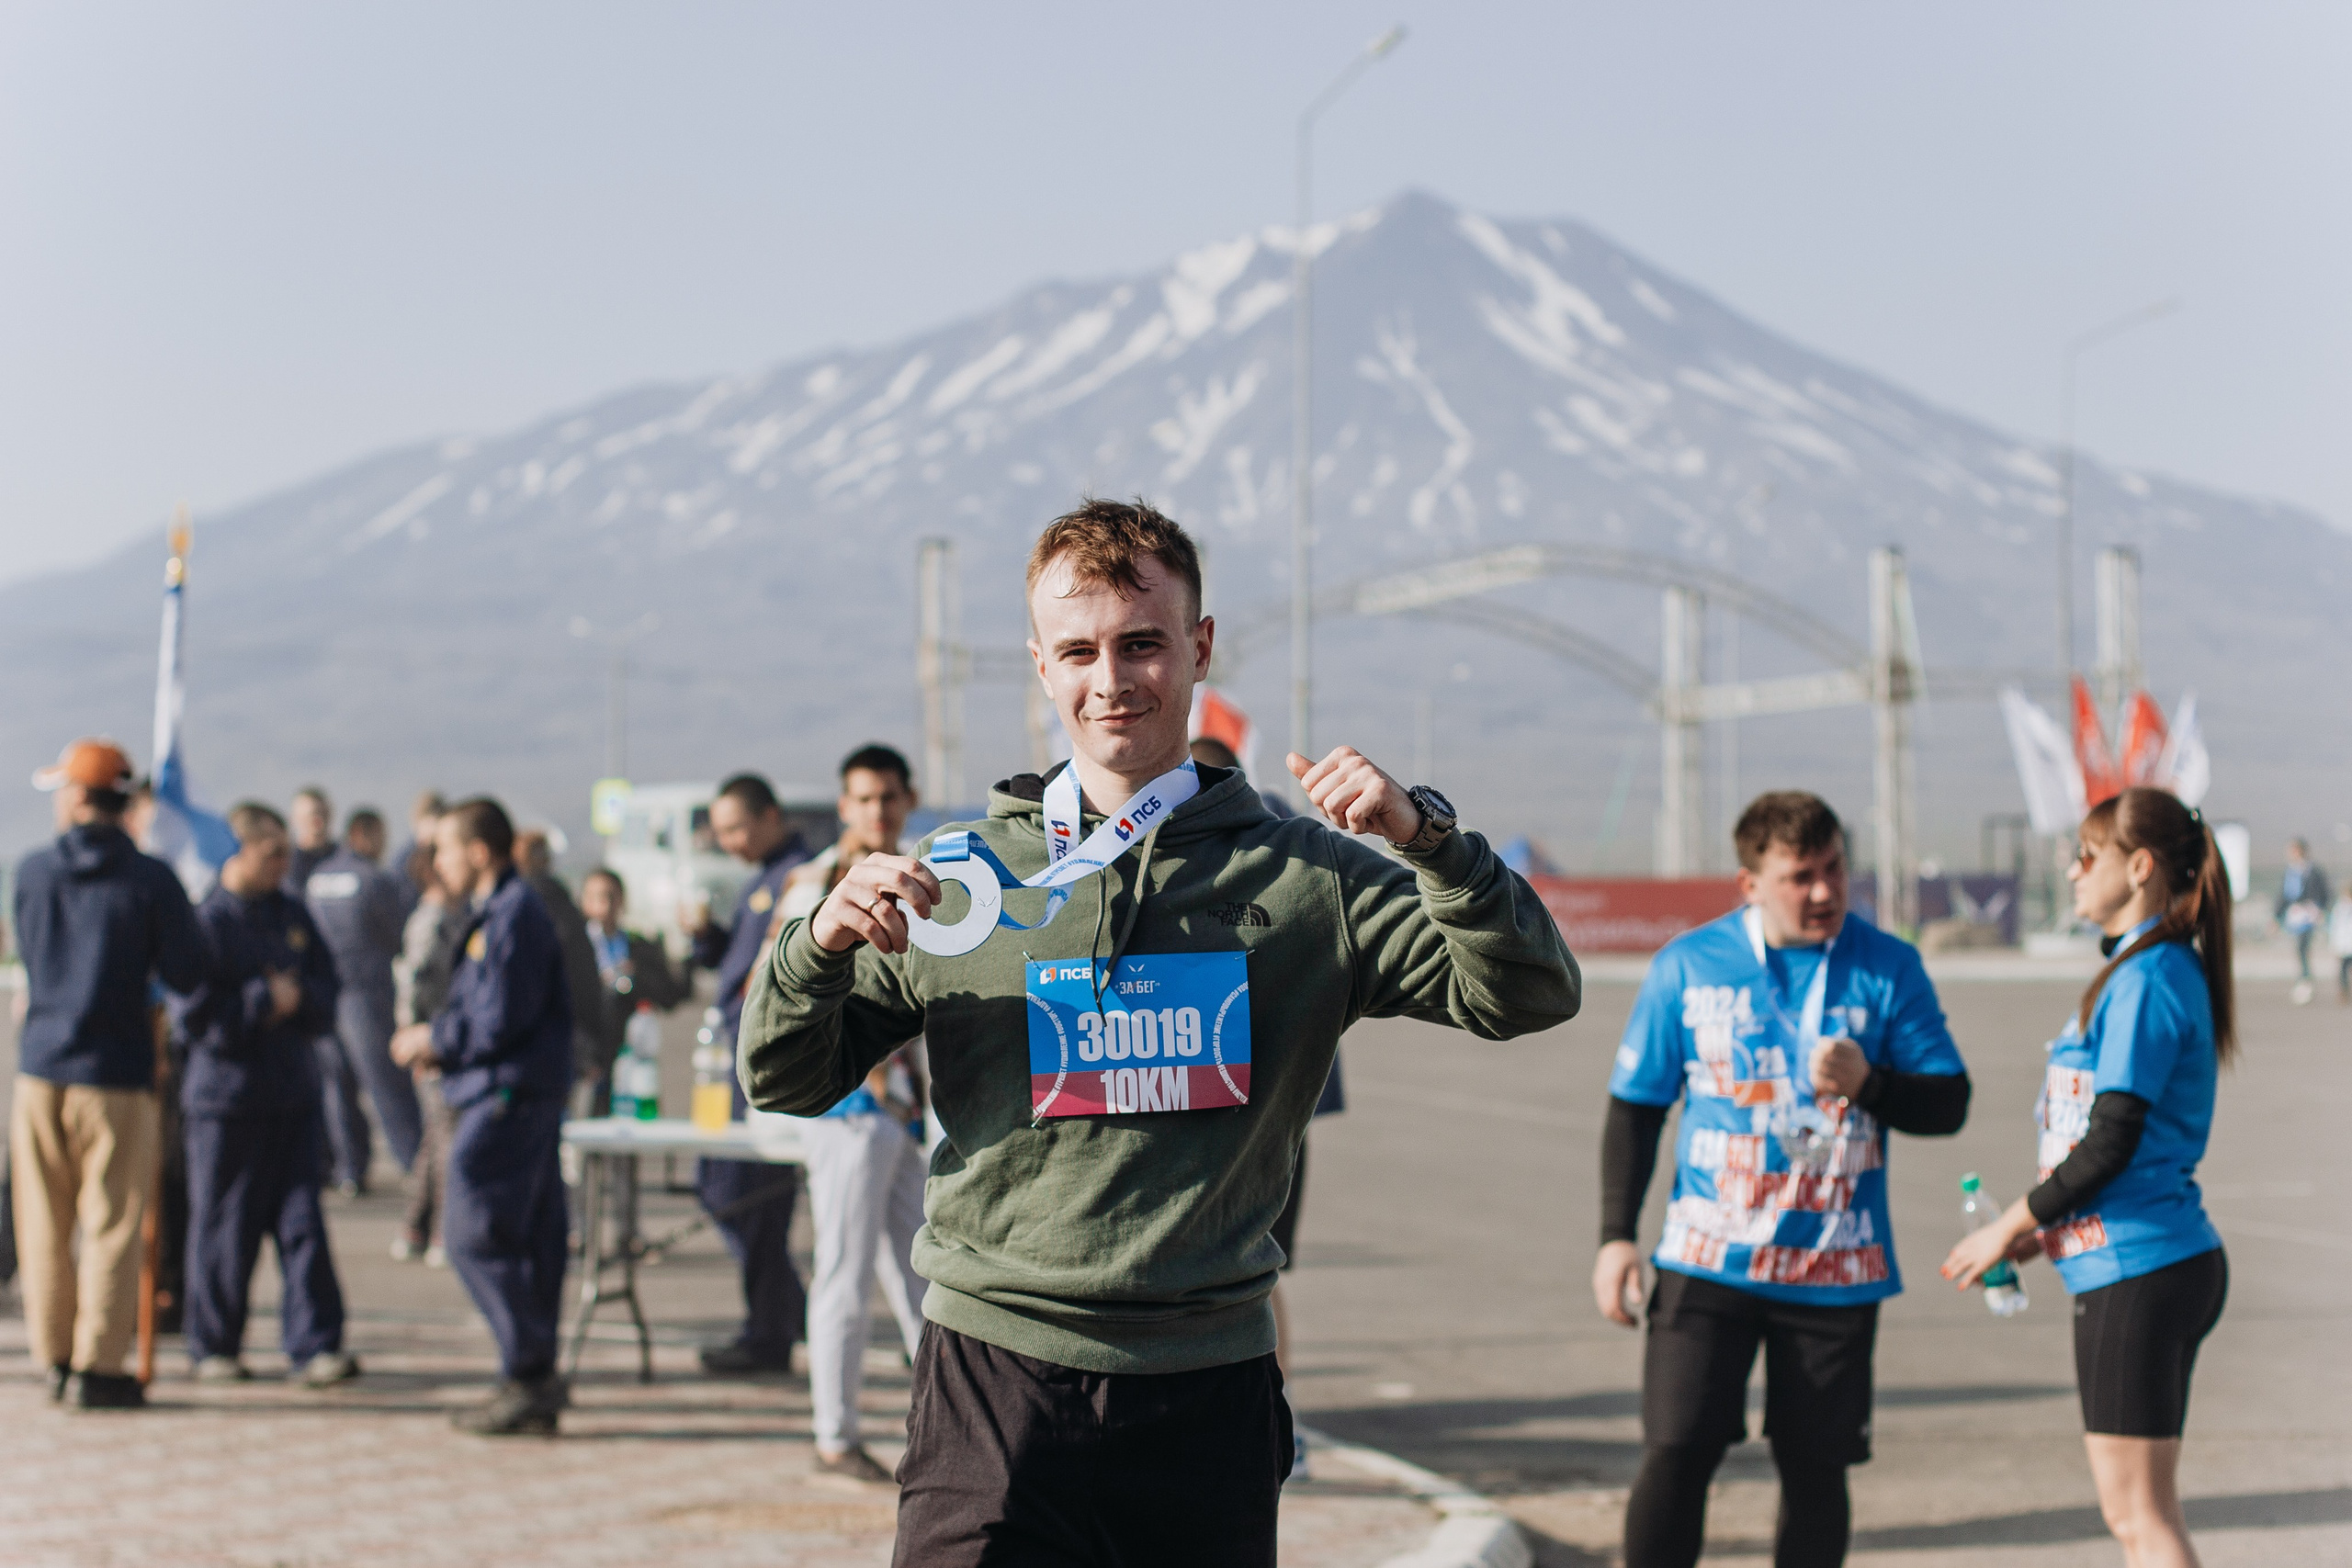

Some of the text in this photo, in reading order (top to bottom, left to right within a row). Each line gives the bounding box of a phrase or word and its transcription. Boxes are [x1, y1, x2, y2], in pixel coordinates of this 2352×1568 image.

[1131, 795, 1161, 825] ПСБ
[1055, 838, 1068, 863] ПС
[1207, 909, 1249, 919] NORTH
[1225, 902, 1248, 912] THE
[1221, 918, 1250, 926] FACE
[1060, 967, 1093, 980] ПСБ
[1682, 985, 1754, 1029] 2024
[1078, 1007, 1203, 1062] 30019
[1100, 1066, 1190, 1114] 10КМ
